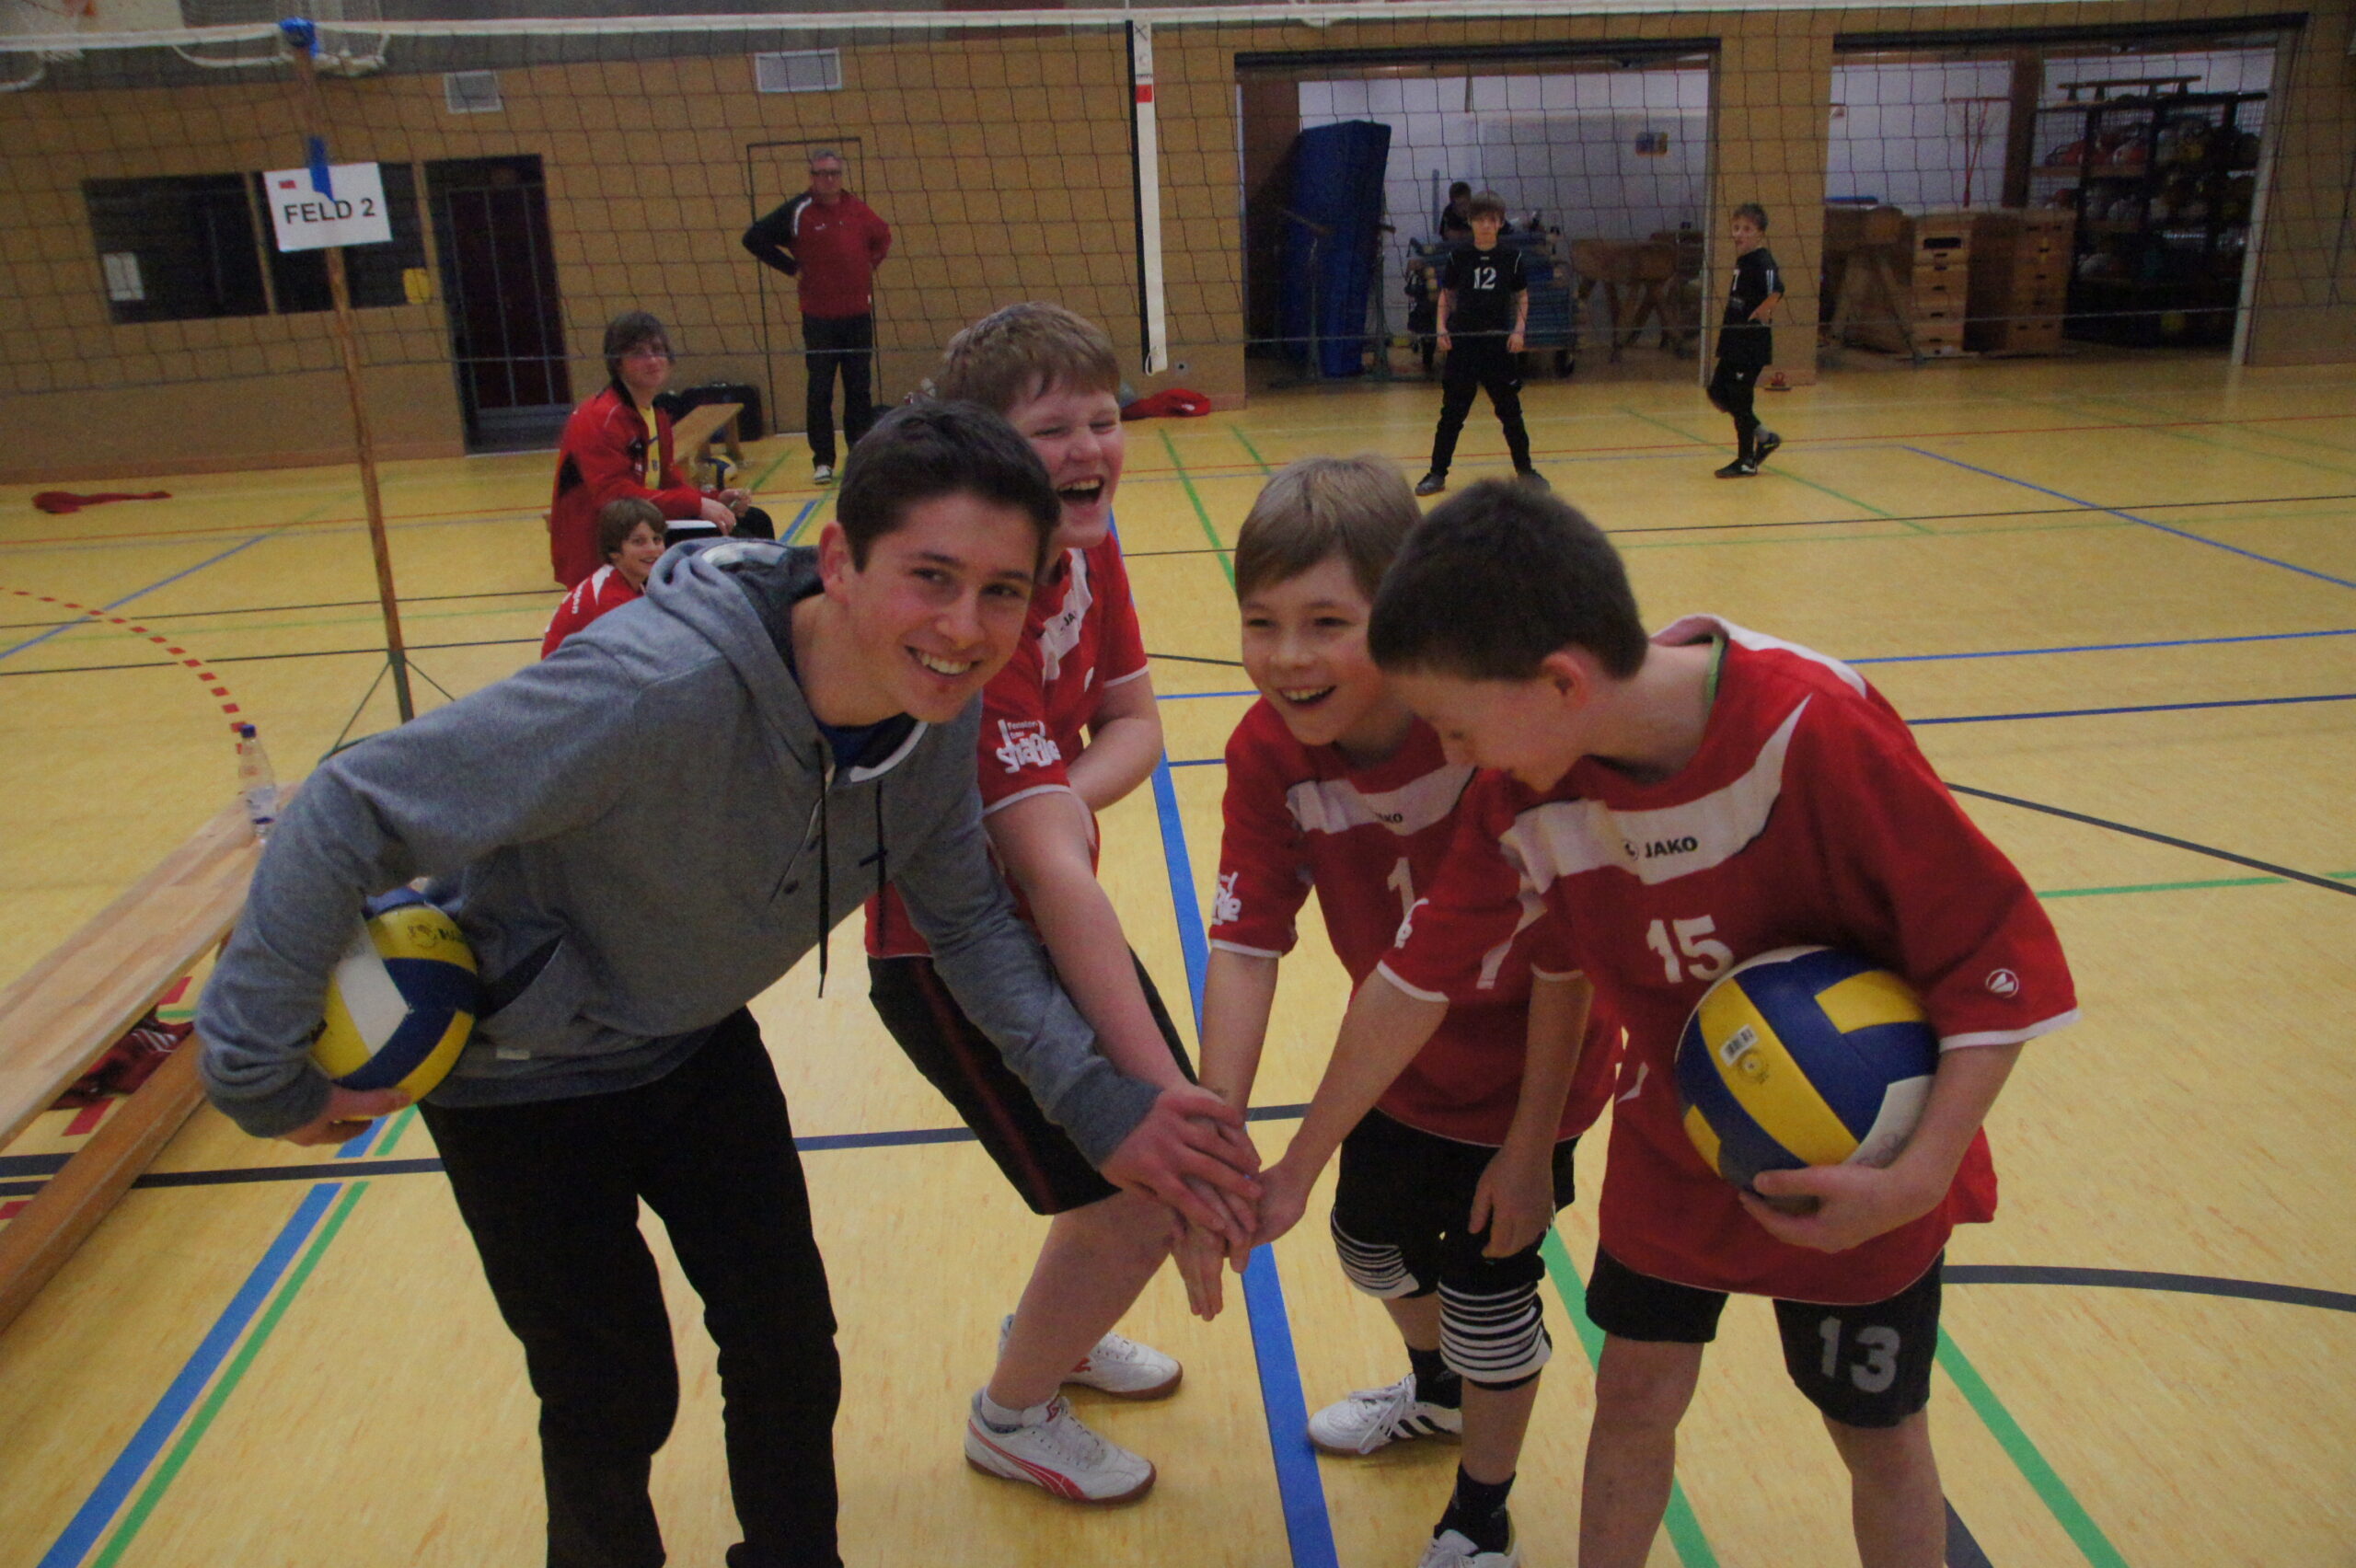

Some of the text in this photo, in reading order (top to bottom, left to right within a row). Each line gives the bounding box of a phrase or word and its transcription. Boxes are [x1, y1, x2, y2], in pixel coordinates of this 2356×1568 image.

[283, 197, 376, 225] FELD 2
[1473, 267, 1497, 290] 12
[1646, 836, 1698, 858] JAKO
[1646, 914, 1735, 985] 15
[1819, 1315, 1900, 1393] 13
